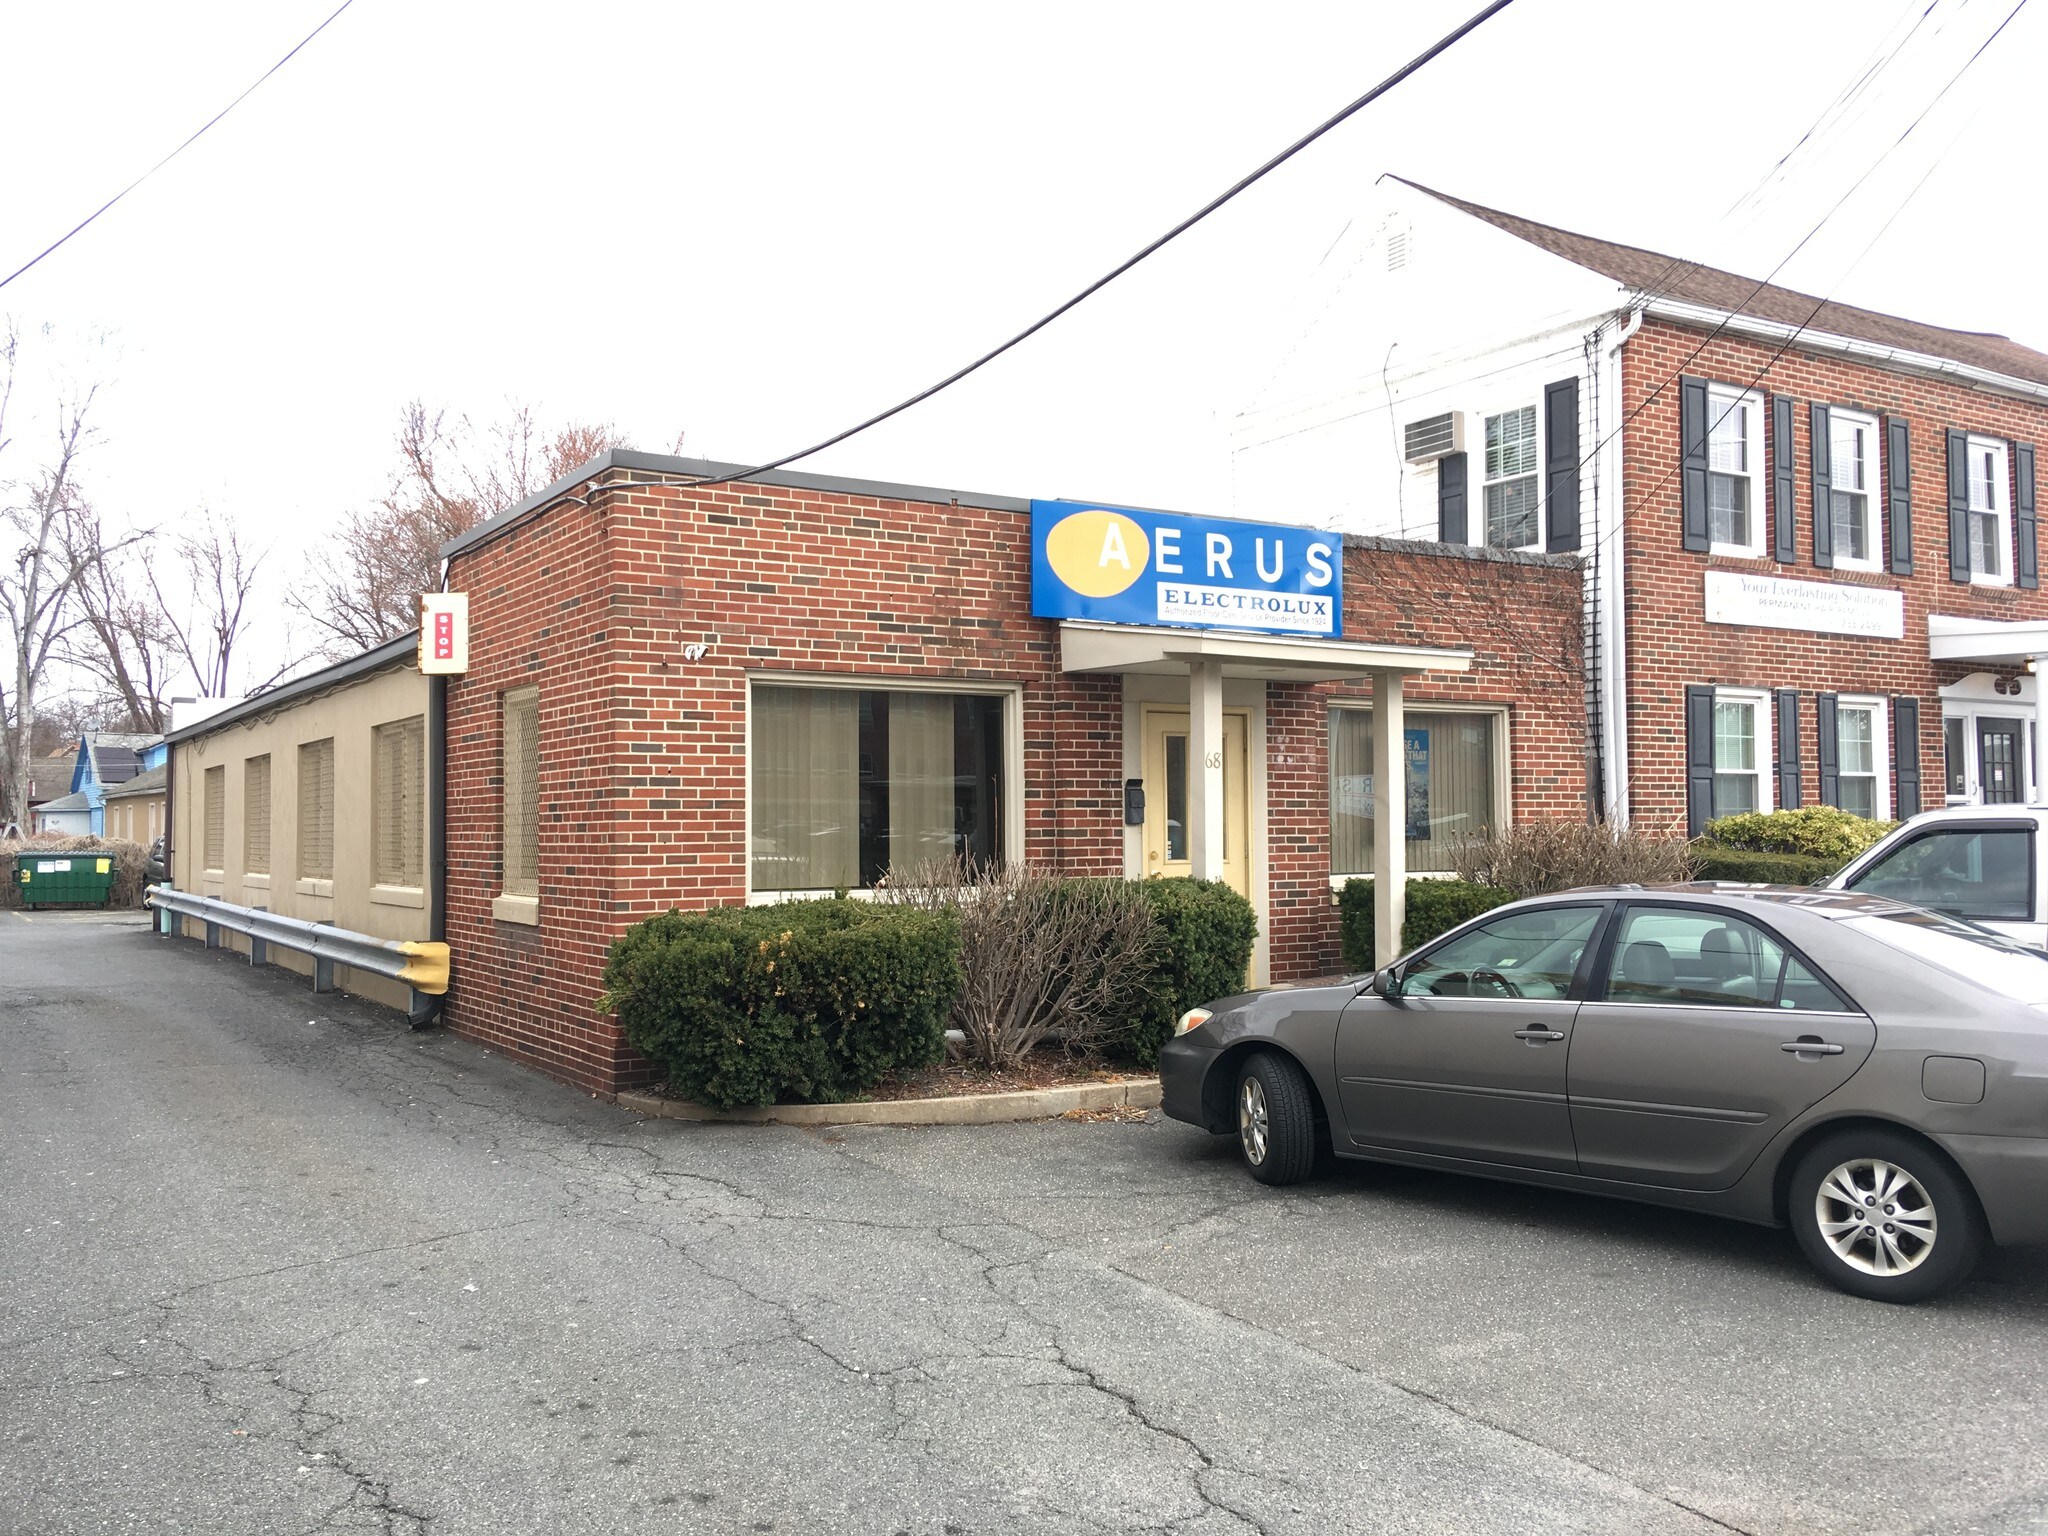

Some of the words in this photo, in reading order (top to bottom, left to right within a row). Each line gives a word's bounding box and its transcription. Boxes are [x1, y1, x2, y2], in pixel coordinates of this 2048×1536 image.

[1098, 522, 1333, 588] AERUS
[1740, 577, 1770, 595] Your
[1772, 581, 1839, 604] Everlasting
[1164, 589, 1327, 616] ELECTROLUX
[1165, 606, 1202, 617] Authorized
[1203, 609, 1220, 618] Floor
[1264, 613, 1291, 624] Provider
[1292, 615, 1310, 625] Since
[439, 615, 449, 657] STOP
[1409, 750, 1428, 761] THAT
[1413, 740, 1420, 750] A
[1205, 751, 1222, 769] 68
